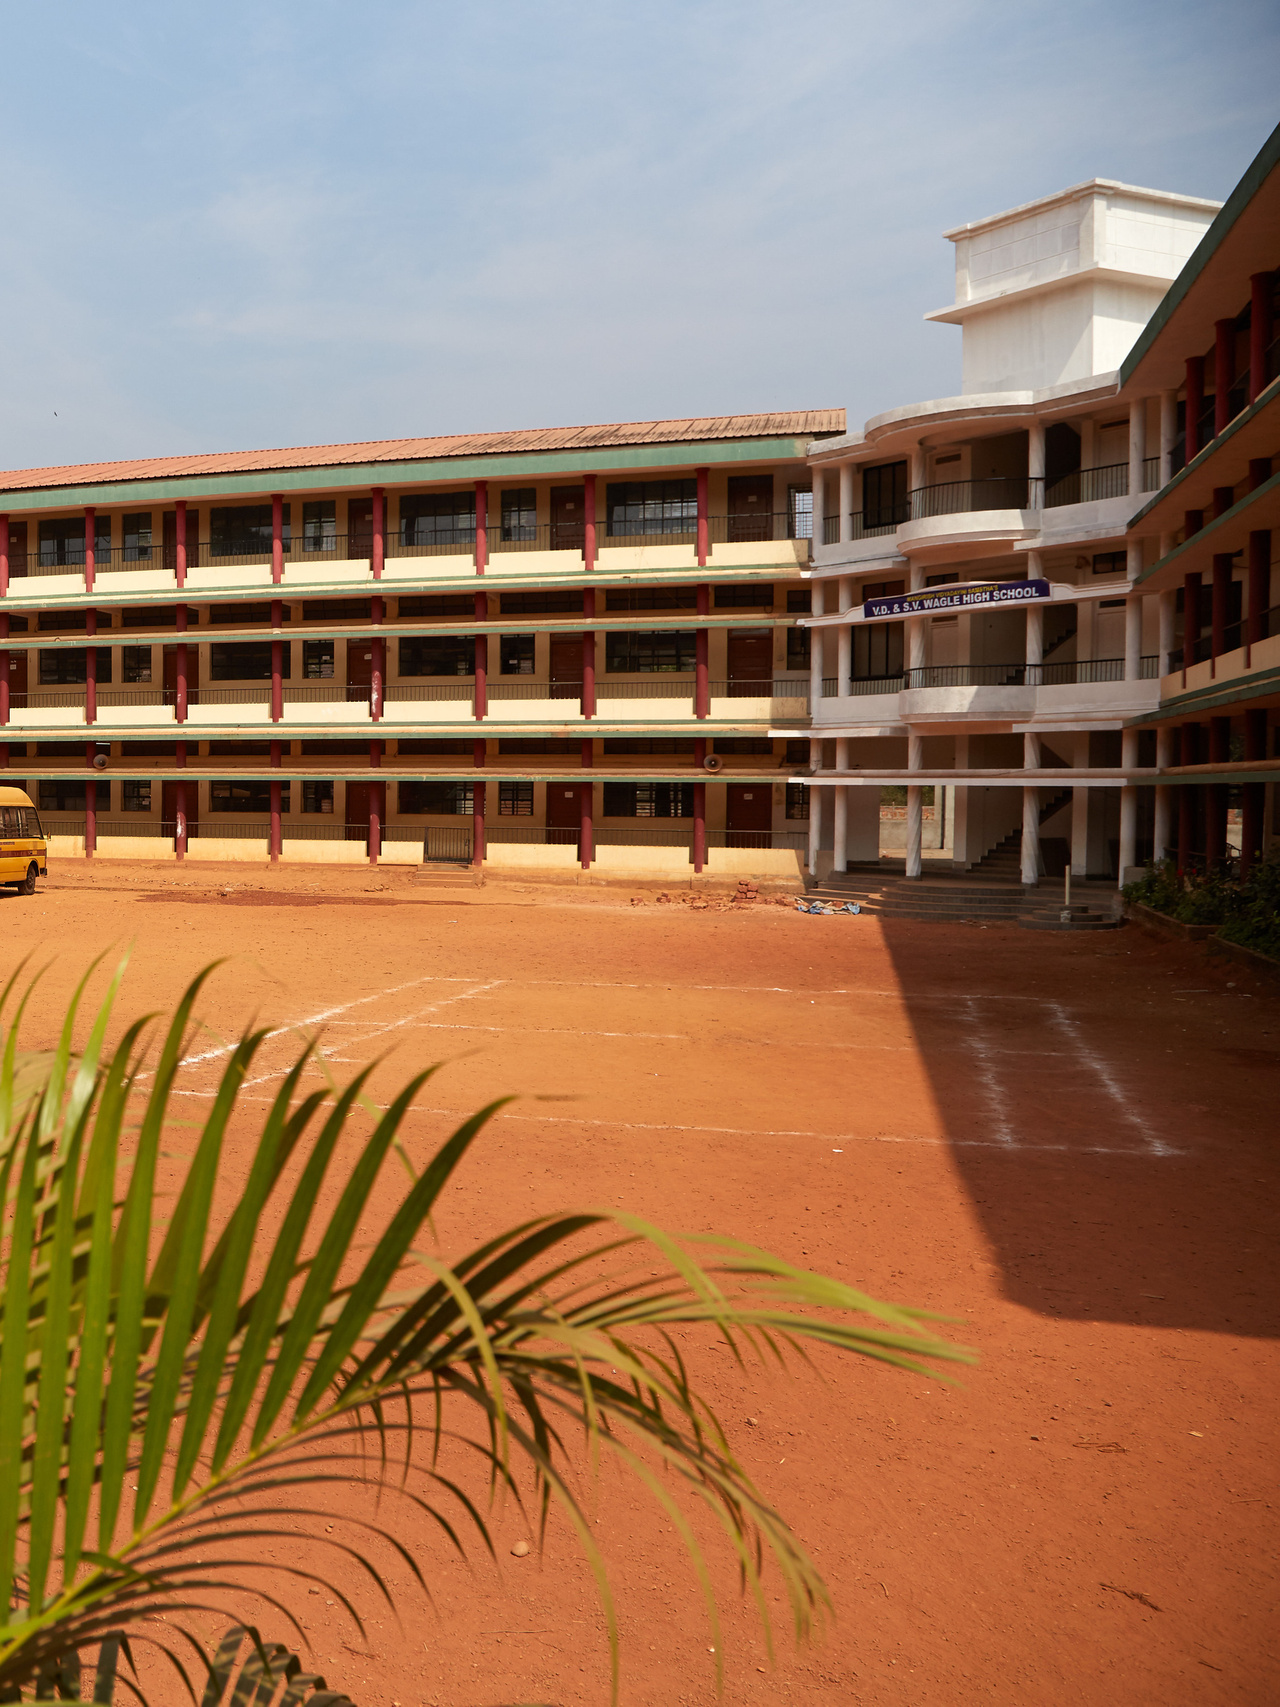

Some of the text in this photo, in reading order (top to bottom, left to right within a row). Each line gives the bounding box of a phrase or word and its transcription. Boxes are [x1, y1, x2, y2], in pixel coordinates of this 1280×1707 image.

[872, 587, 1039, 615] V.D. & S.V. WAGLE HIGH SCHOOL
